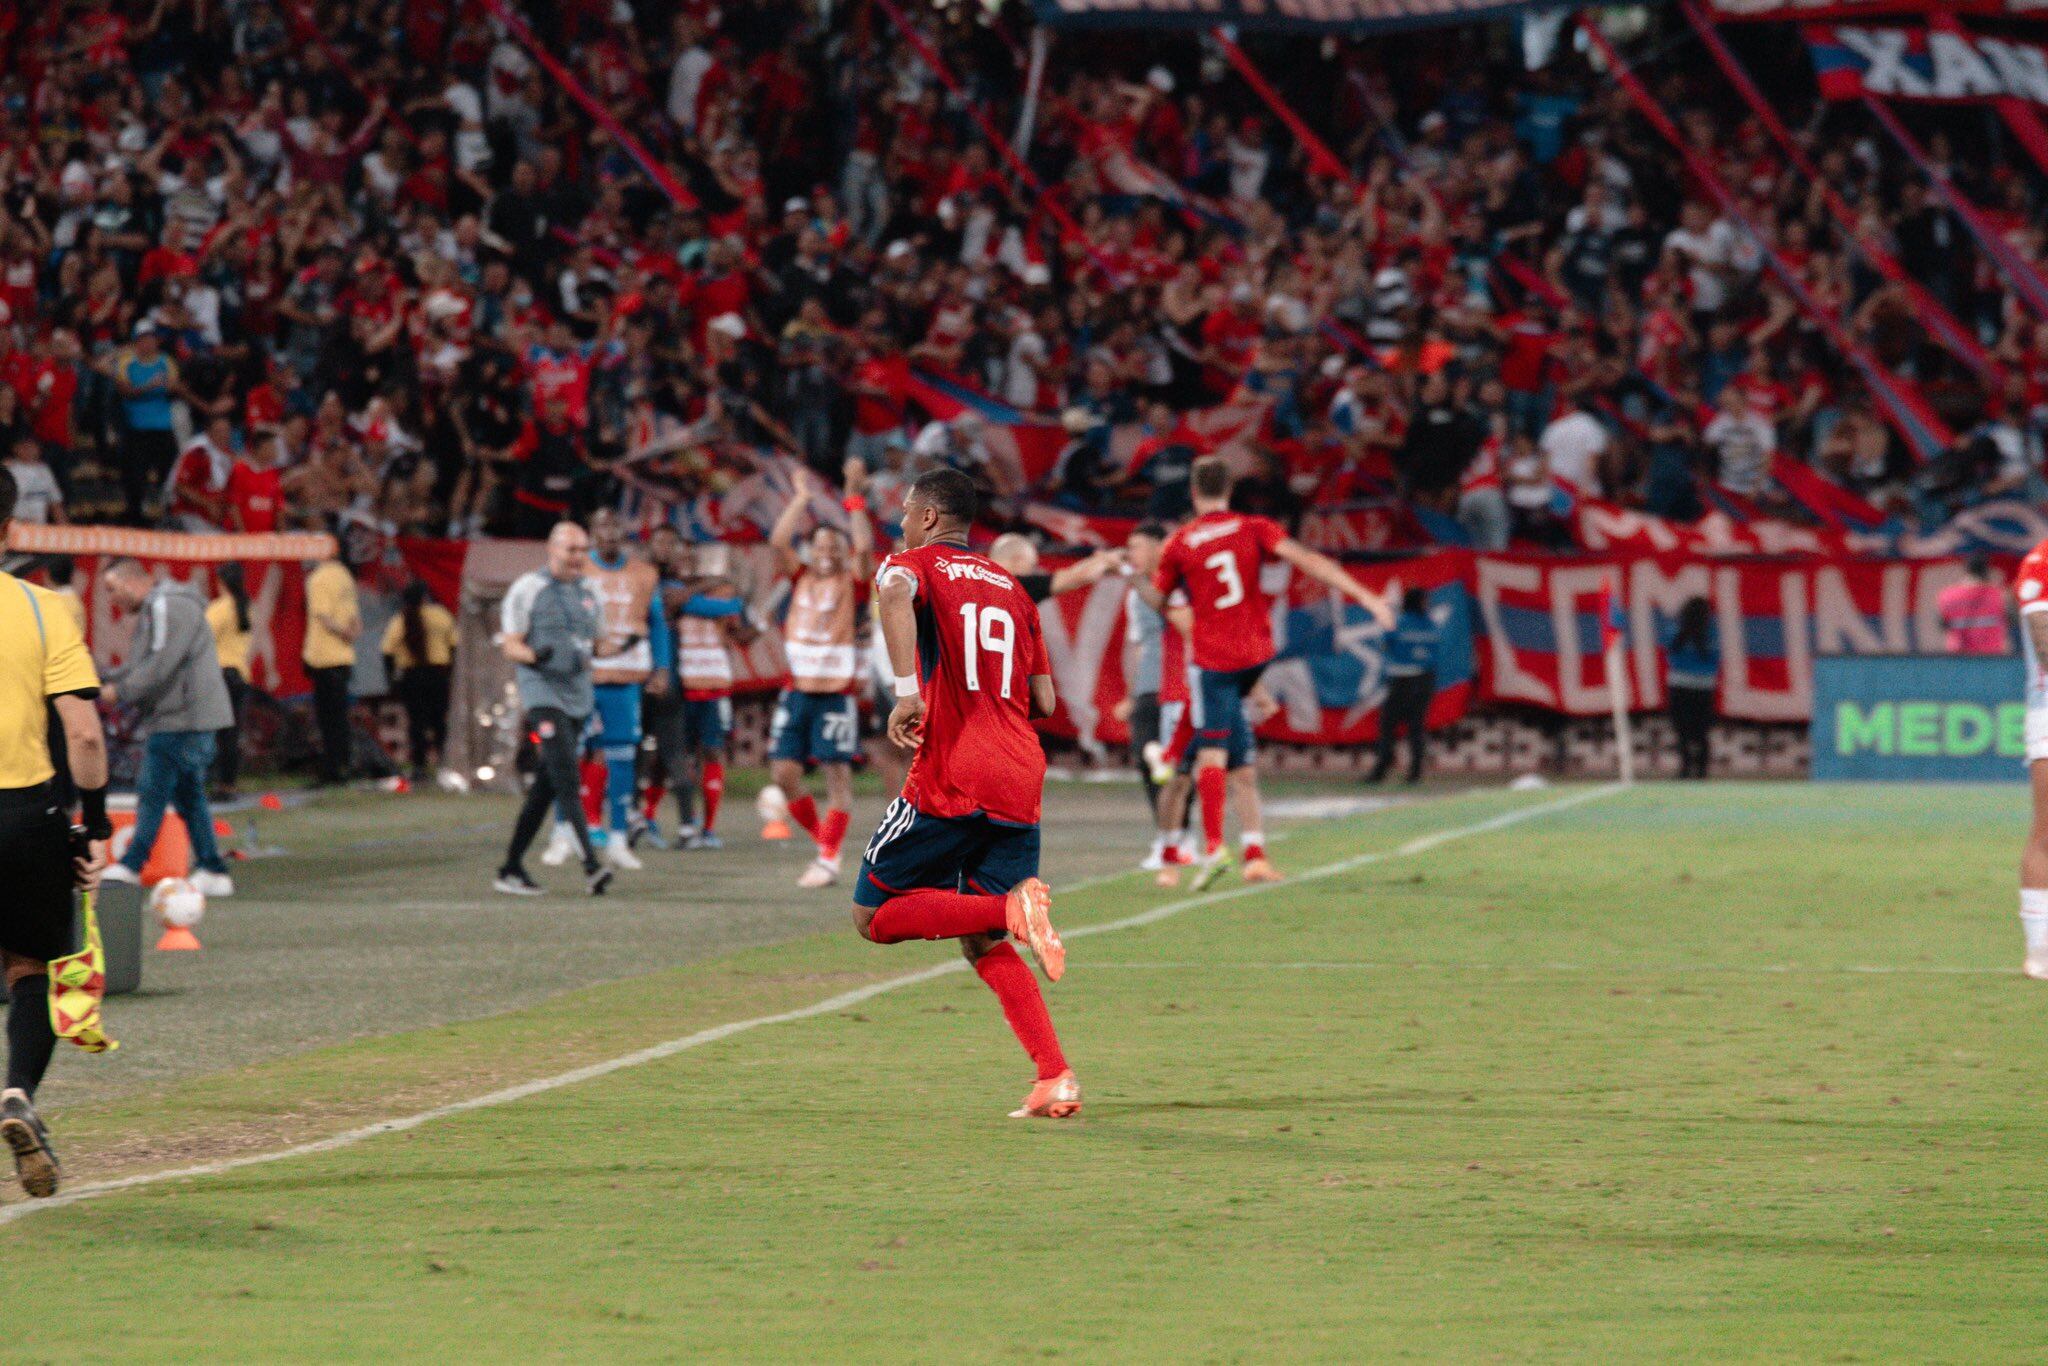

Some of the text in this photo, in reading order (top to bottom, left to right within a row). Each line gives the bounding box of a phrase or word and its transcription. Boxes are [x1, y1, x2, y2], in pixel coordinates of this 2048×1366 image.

[945, 562, 984, 582] JFK
[1204, 549, 1245, 610] 3
[960, 602, 1015, 699] 19
[1836, 702, 2028, 757] MEDE
